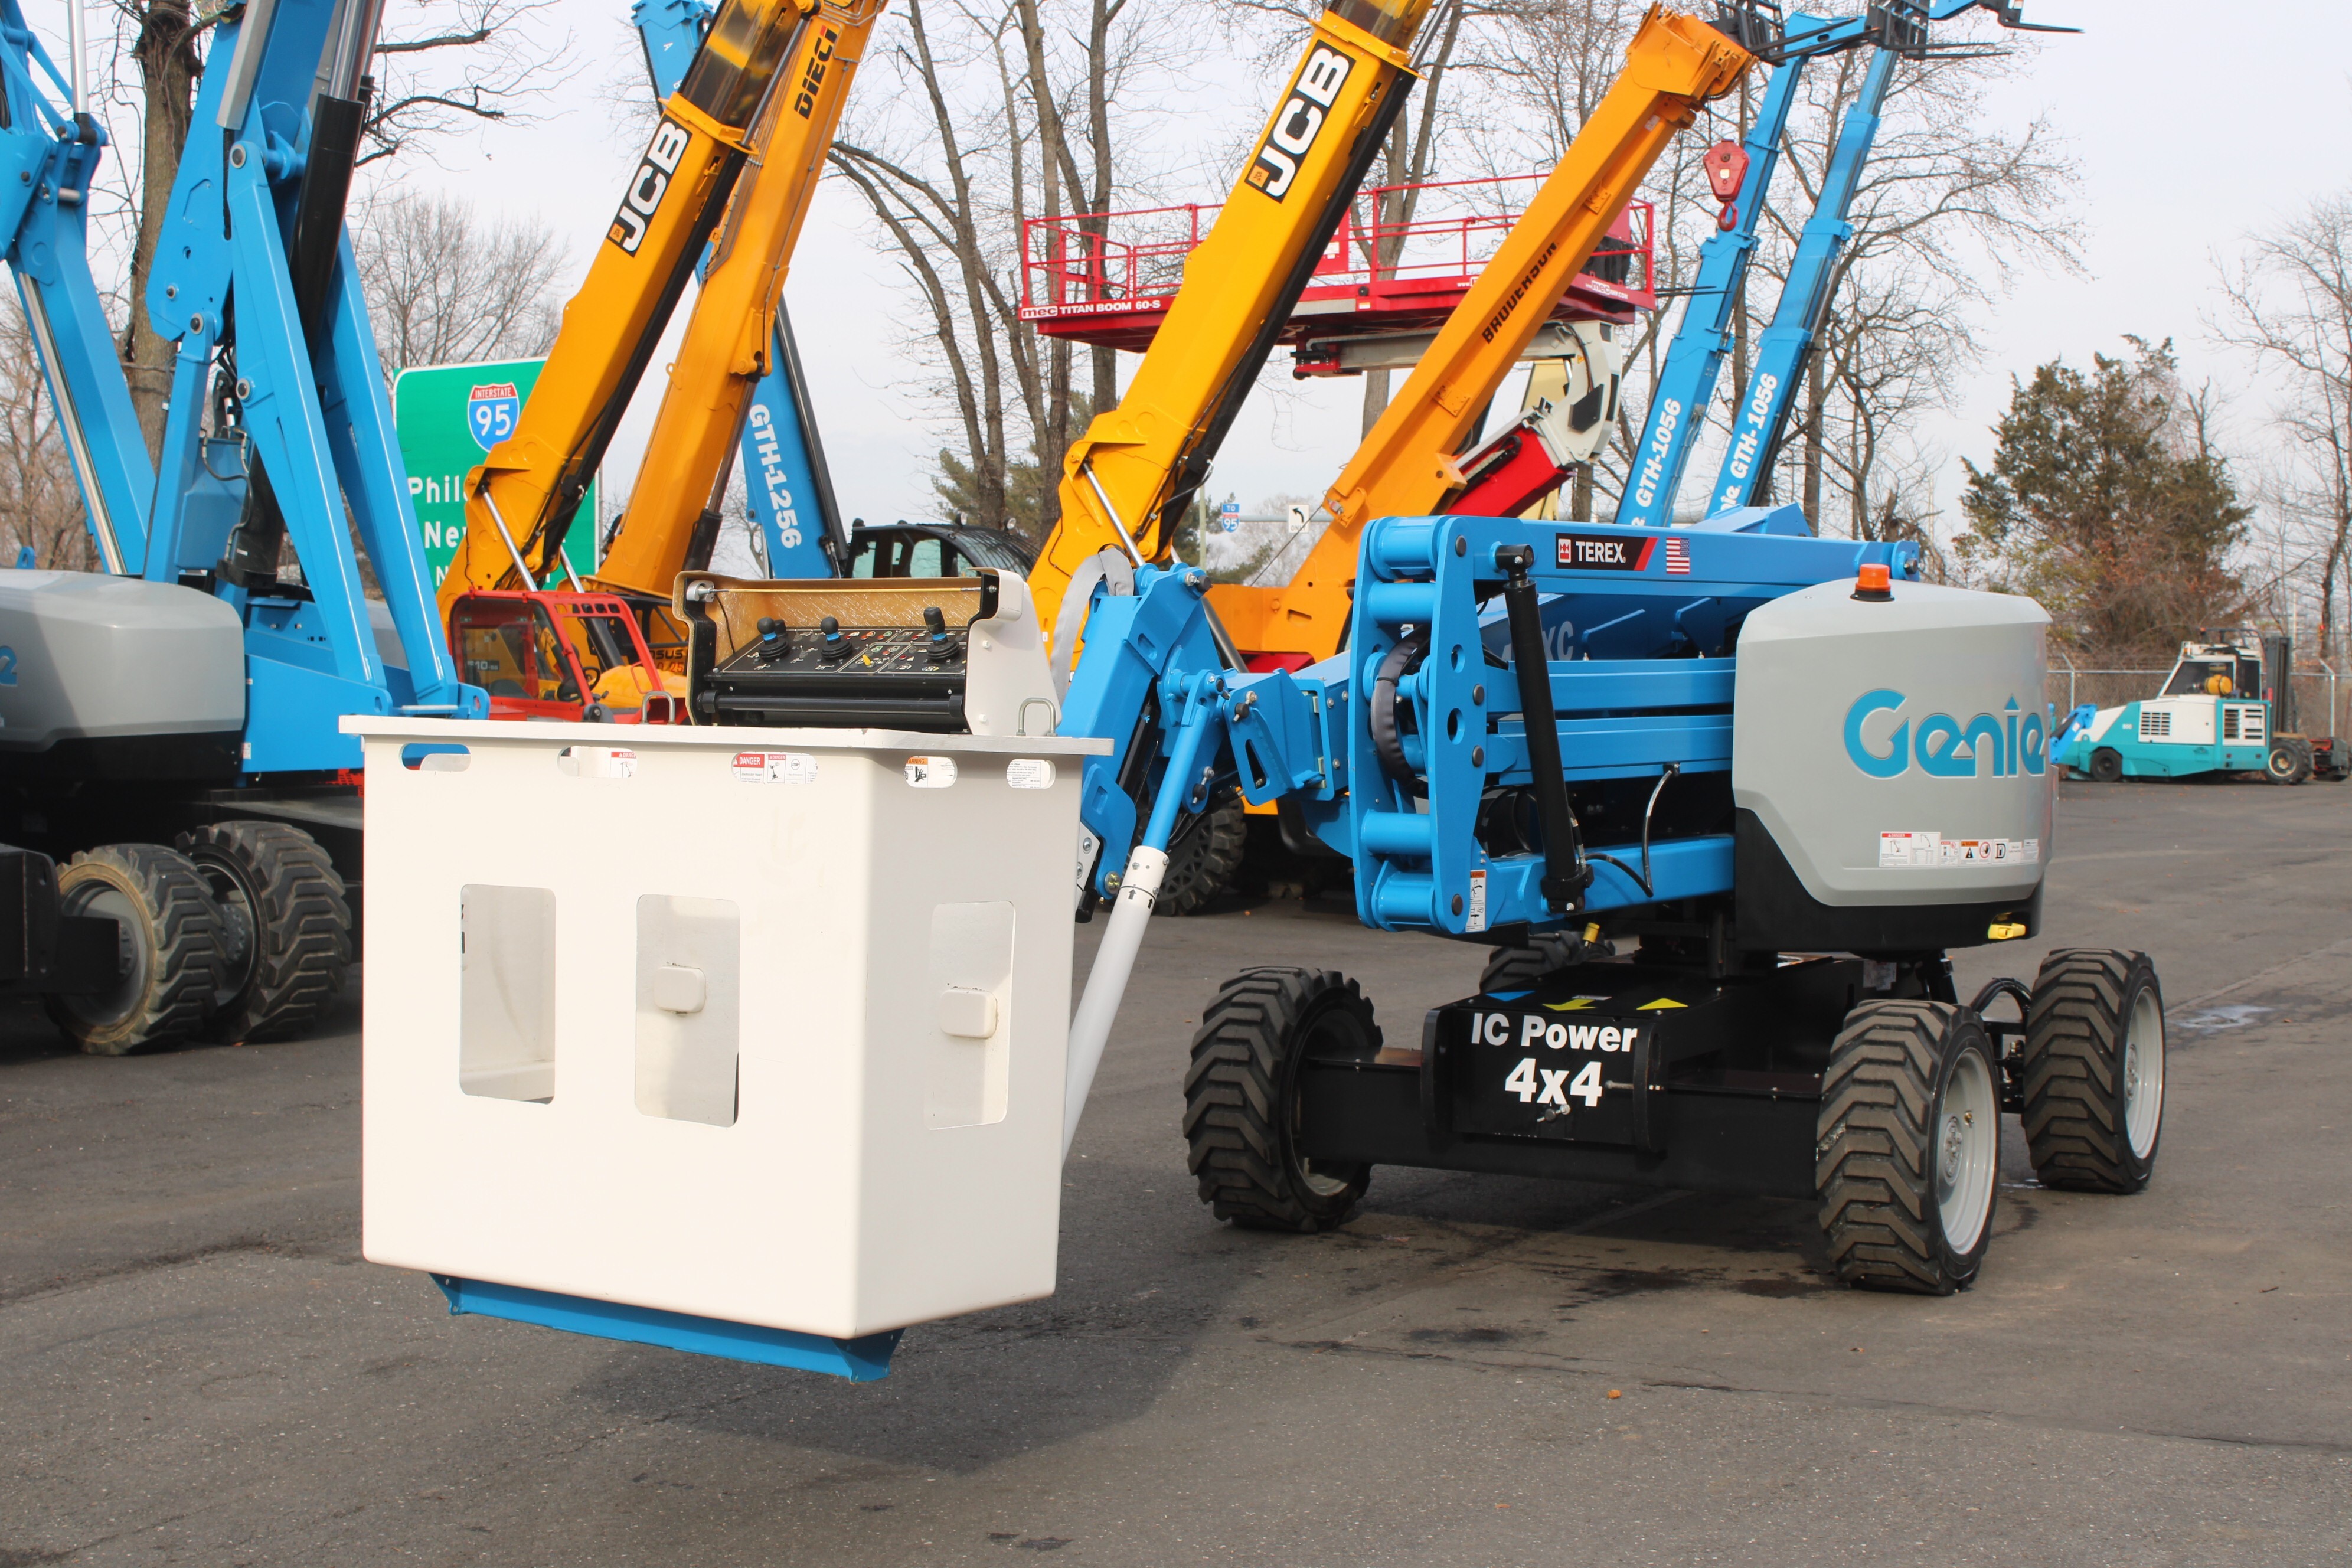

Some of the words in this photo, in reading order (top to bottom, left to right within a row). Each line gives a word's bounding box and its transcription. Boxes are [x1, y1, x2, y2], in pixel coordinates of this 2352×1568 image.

[663, 42, 673, 52] A
[1262, 48, 1350, 197] JCB
[619, 121, 689, 252] JCB
[1023, 307, 1057, 318] mec
[1060, 304, 1094, 315] TITAN
[1096, 302, 1132, 312] BOOM
[1135, 300, 1161, 309] 60-S
[475, 387, 512, 399] INTERSTATE
[476, 404, 511, 436] 95
[1730, 373, 1778, 479] GTH-1056
[1635, 398, 1681, 507] GTH-1056
[408, 475, 468, 504] Phil
[749, 404, 802, 548] GTH-1256
[1224, 518, 1238, 529] 95
[1576, 541, 1624, 563] TEREX
[1842, 688, 2044, 780] Genie
[739, 757, 760, 765] DANGER
[1471, 1012, 1510, 1046] IC
[1521, 1015, 1637, 1053] Power
[1504, 1057, 1603, 1107] 4x4
